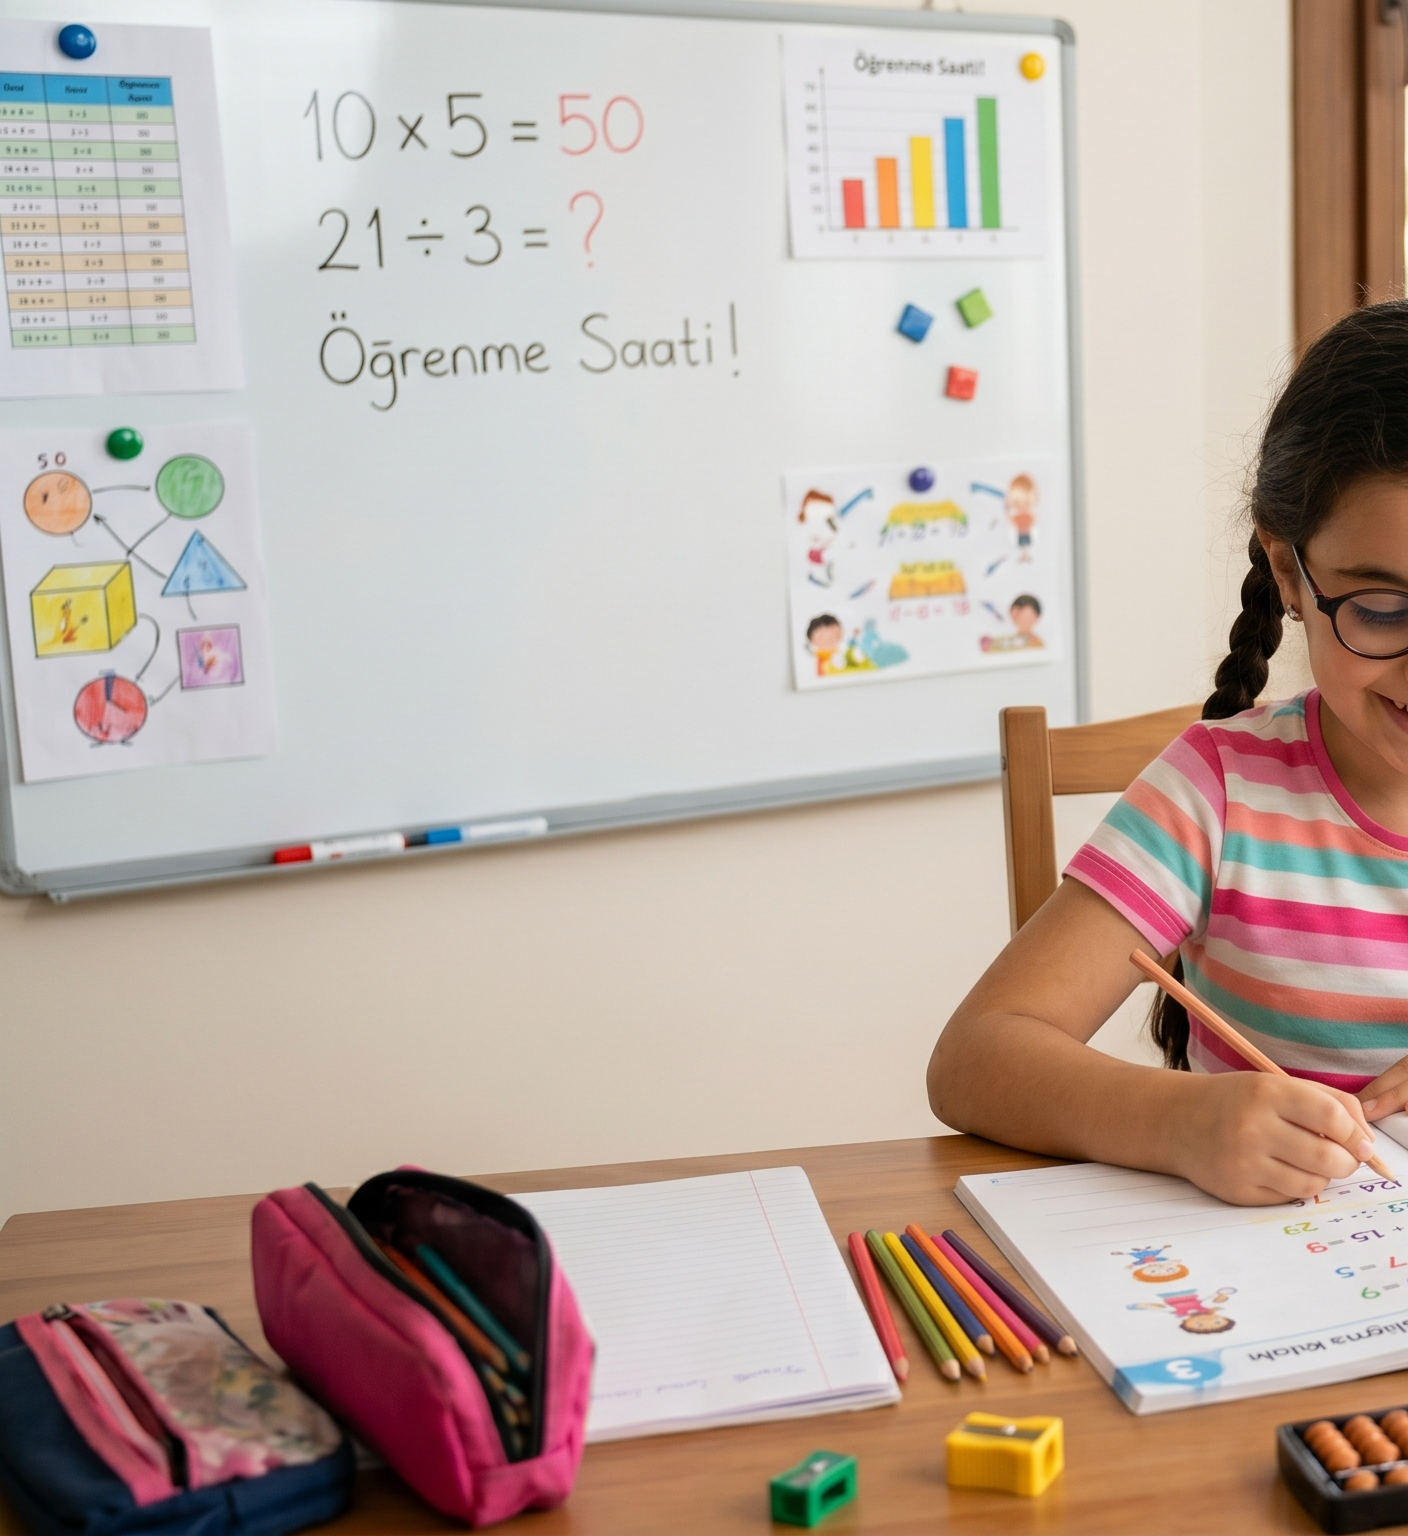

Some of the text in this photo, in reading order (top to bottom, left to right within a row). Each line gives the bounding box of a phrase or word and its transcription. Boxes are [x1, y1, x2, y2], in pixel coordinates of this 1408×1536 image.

[854, 52, 933, 76] Öğrenme
[304, 90, 378, 162] 10
[447, 92, 488, 158] 5
[511, 120, 539, 143] =
[558, 93, 645, 156] 50
[317, 190, 605, 272] 21 ÷ 3 = ?
[320, 302, 740, 411] Öğrenme Saati!
[1350, 1229, 1385, 1243] 15
[1335, 1266, 1355, 1279] 5
[1389, 1256, 1408, 1269] 7
[1361, 1287, 1381, 1300] 9
[1164, 1358, 1203, 1380] 3
